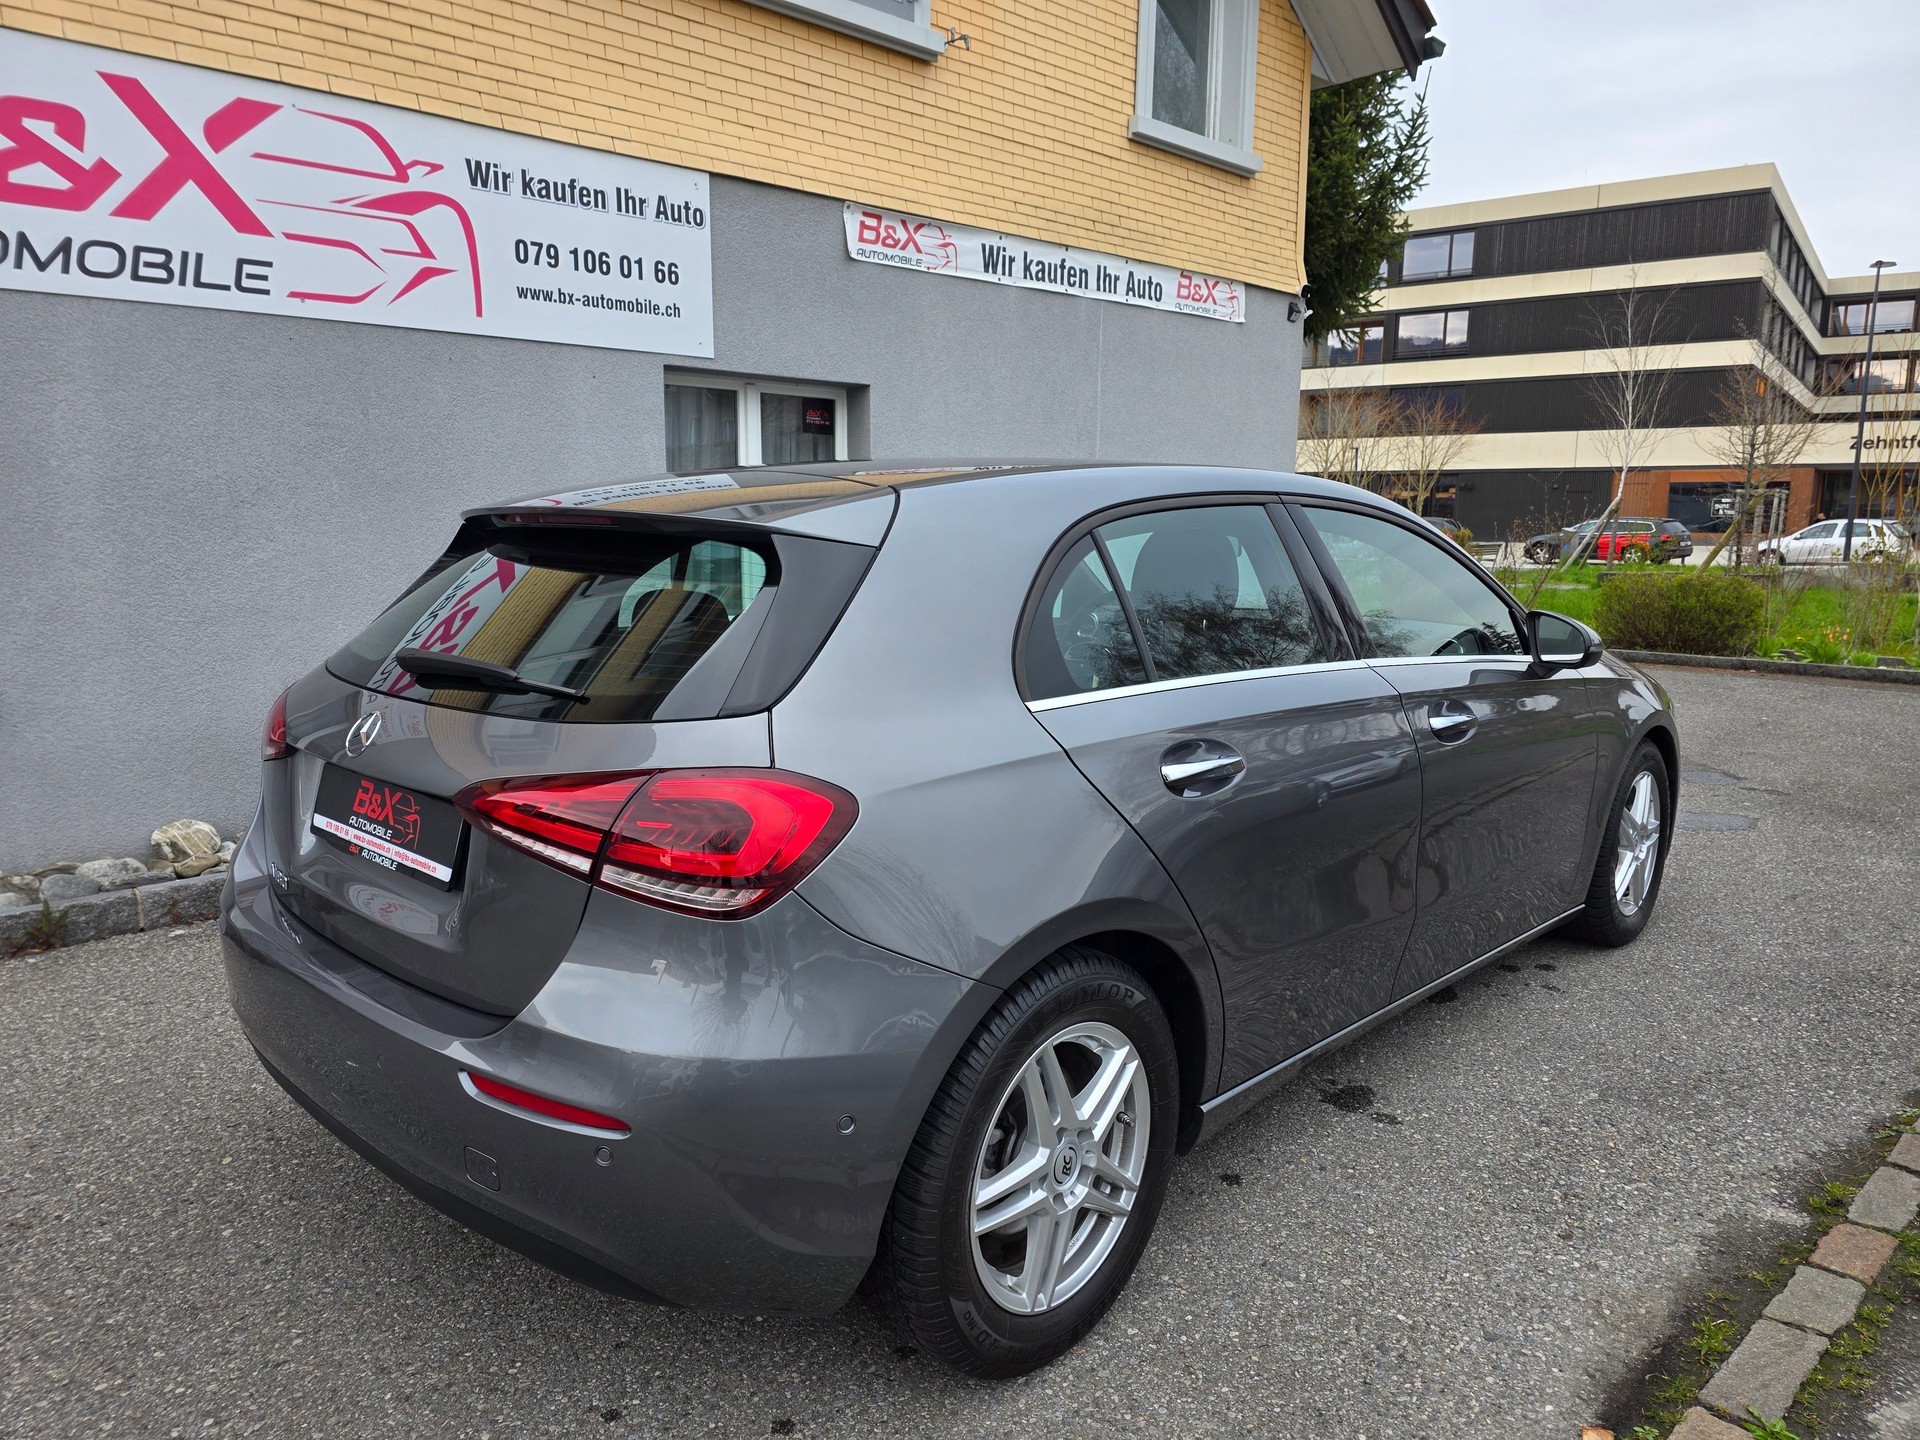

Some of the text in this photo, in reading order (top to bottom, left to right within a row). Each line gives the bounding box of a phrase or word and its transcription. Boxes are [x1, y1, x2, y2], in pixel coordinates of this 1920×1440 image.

[465, 158, 705, 227] Wir kaufen Ihr Auto
[858, 211, 927, 254] B&X
[0, 230, 273, 296] MOBILE
[514, 238, 680, 286] 079 106 01 66
[856, 248, 923, 268] AUTOMOBILE
[981, 243, 1163, 302] Wir kaufen Ihr Auto
[516, 286, 681, 318] www.bx-automobile.ch
[1177, 273, 1220, 306] B&X
[1175, 302, 1218, 317] AUTOMOBILE
[352, 779, 403, 825] B&X
[349, 815, 392, 840] AUTOMOBILE
[361, 849, 399, 871] AUTOMOBILE
[1043, 982, 1136, 1021] DUNLOP
[1061, 1154, 1074, 1177] RC
